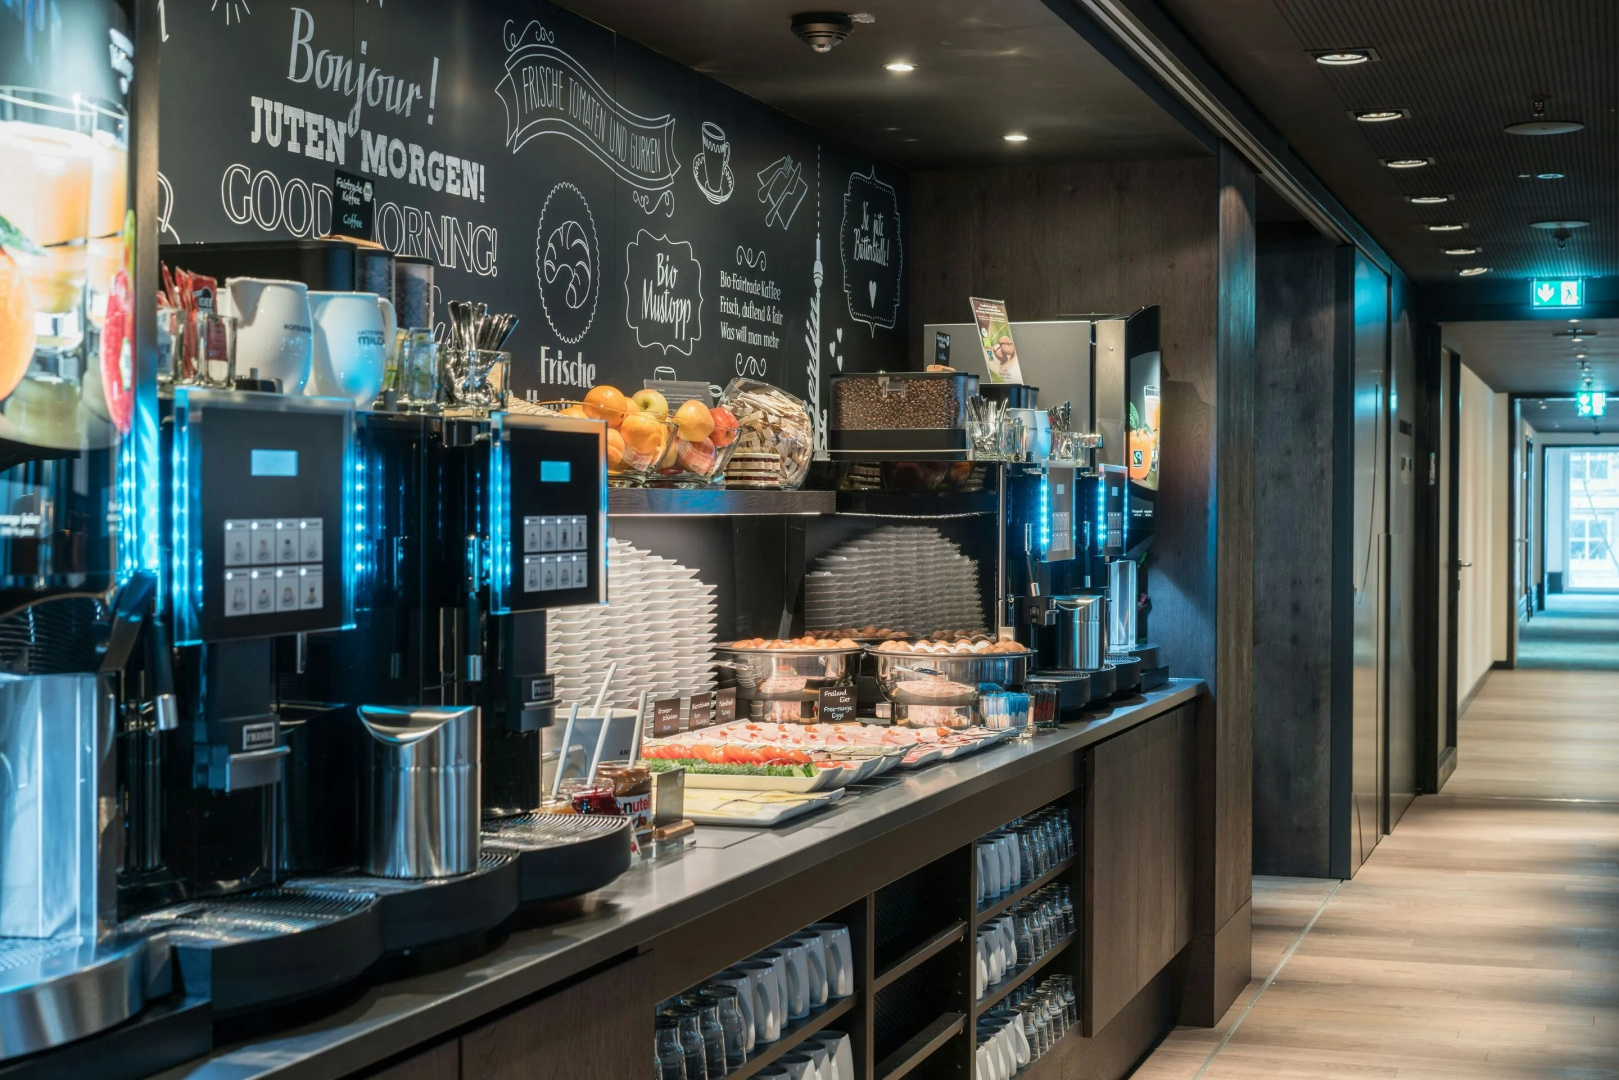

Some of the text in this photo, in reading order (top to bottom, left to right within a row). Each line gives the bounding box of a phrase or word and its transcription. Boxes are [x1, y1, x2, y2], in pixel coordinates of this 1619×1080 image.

[286, 7, 440, 138] Bonjour!
[522, 65, 661, 173] FRISCHE TOMATEN UND GURKEN
[250, 95, 486, 203] JUTEN MORGEN!
[221, 163, 498, 278] GOOD ORNING!
[342, 213, 363, 229] Coffee
[656, 252, 678, 289] Bio
[761, 280, 782, 301] Kaffee
[641, 278, 692, 341] Mustopp
[720, 295, 784, 326] Frisch, duftend & fair
[720, 321, 780, 349] Was will man mehr
[540, 345, 596, 389] Frische
[824, 689, 847, 698] Freiland
